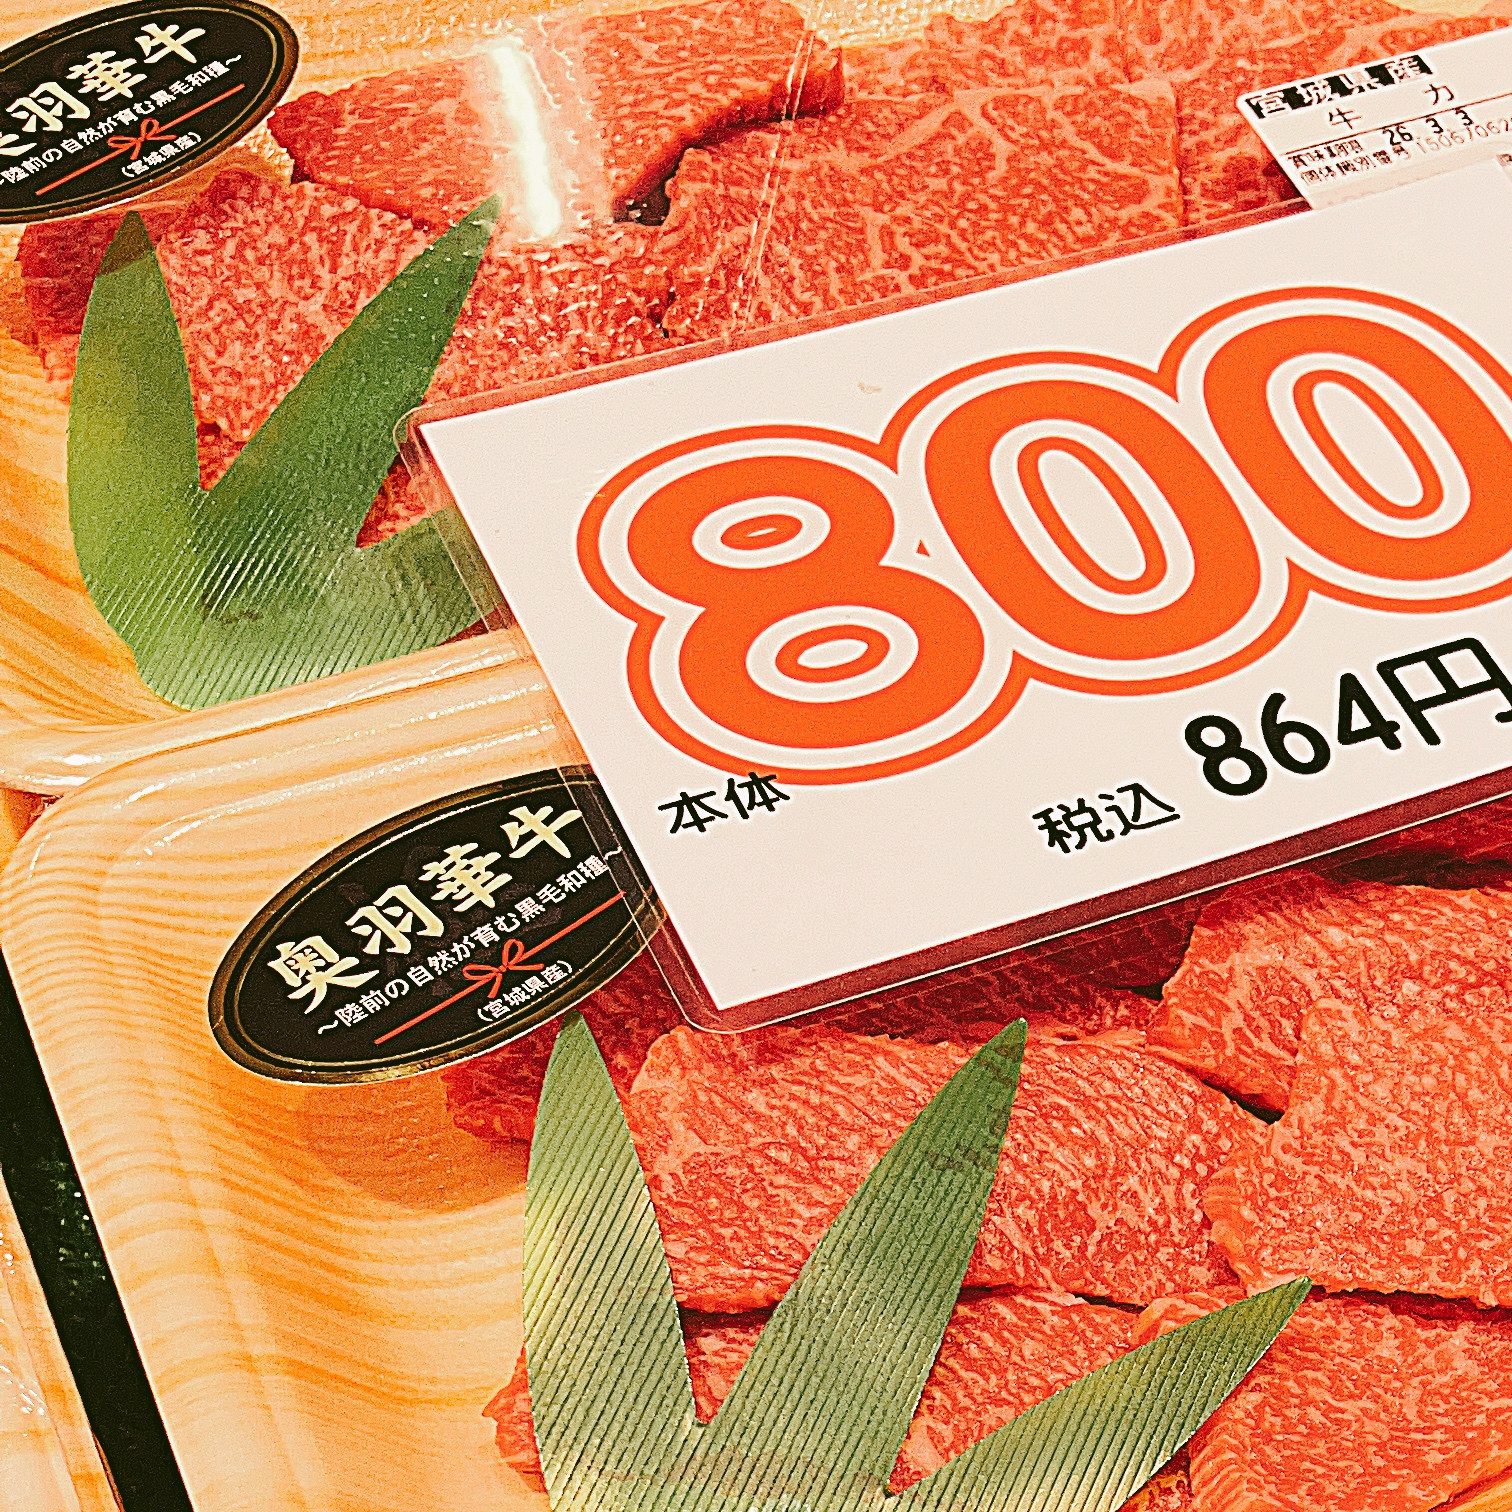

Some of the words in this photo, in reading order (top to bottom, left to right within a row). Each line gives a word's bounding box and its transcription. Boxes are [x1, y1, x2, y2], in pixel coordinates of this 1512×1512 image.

[658, 771, 791, 838] 本体
[1031, 783, 1181, 853] 税込
[267, 805, 583, 1014] 奥羽華牛
[477, 960, 574, 1023] (宮城県産)
